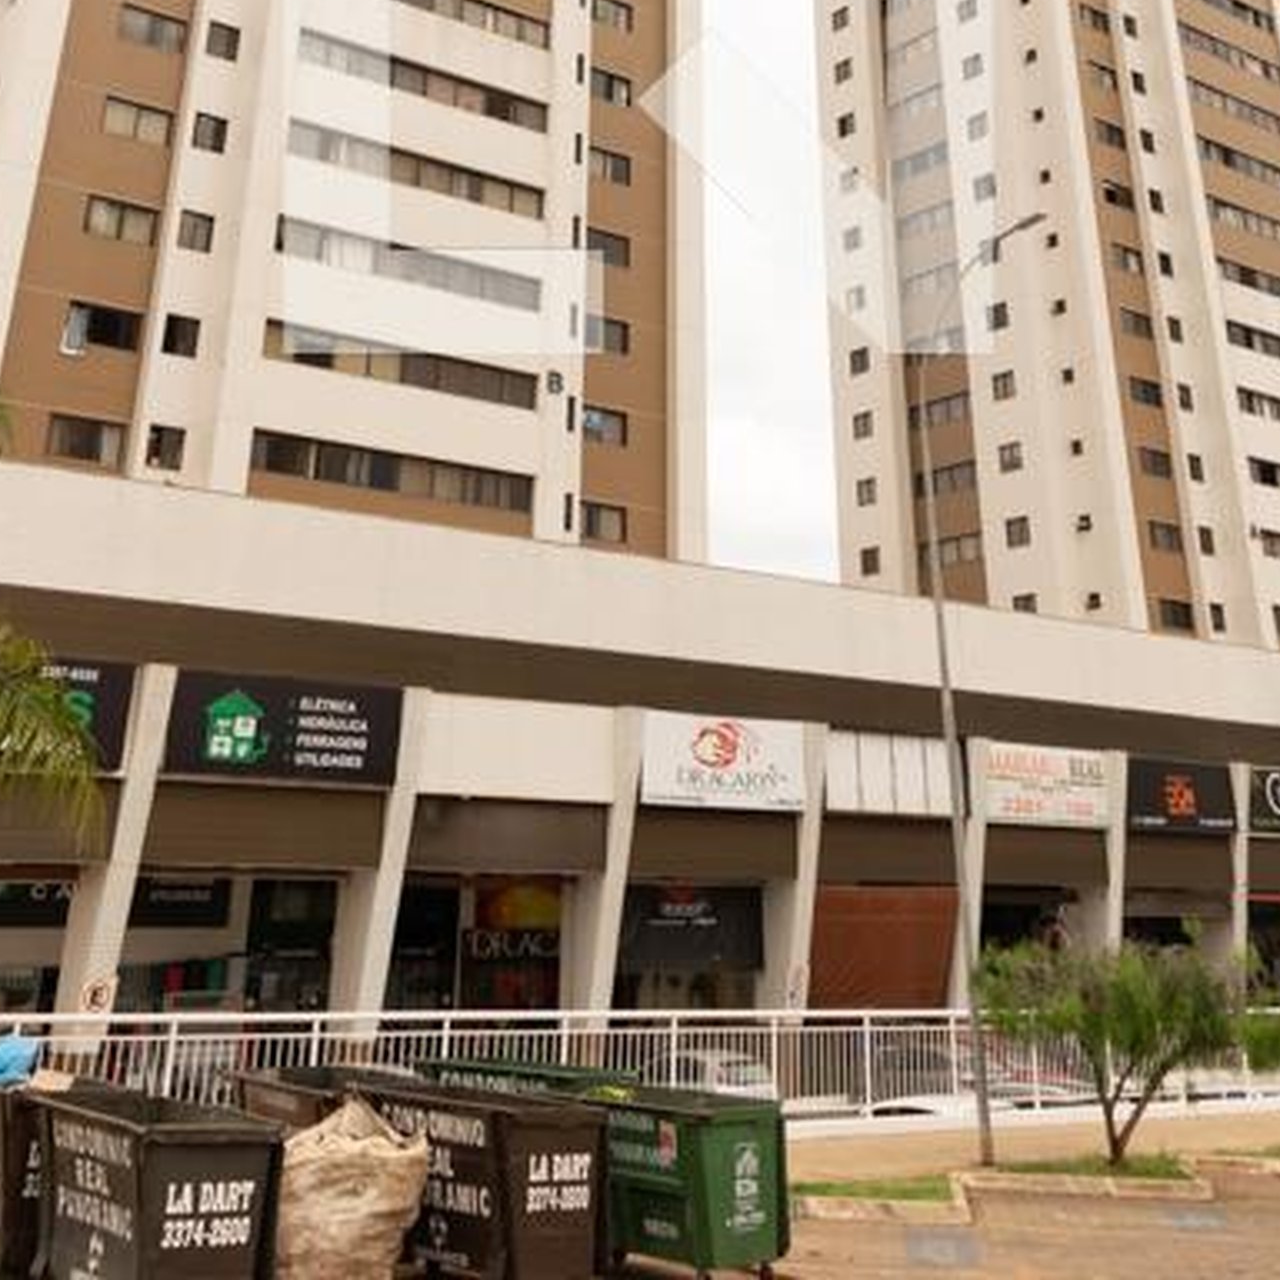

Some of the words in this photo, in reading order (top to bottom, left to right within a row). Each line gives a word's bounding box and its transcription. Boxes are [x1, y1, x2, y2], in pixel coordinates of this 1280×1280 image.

[547, 371, 564, 394] B
[528, 1153, 549, 1182] LA
[552, 1151, 592, 1182] DART
[166, 1182, 194, 1215] LA
[199, 1180, 255, 1214] DART
